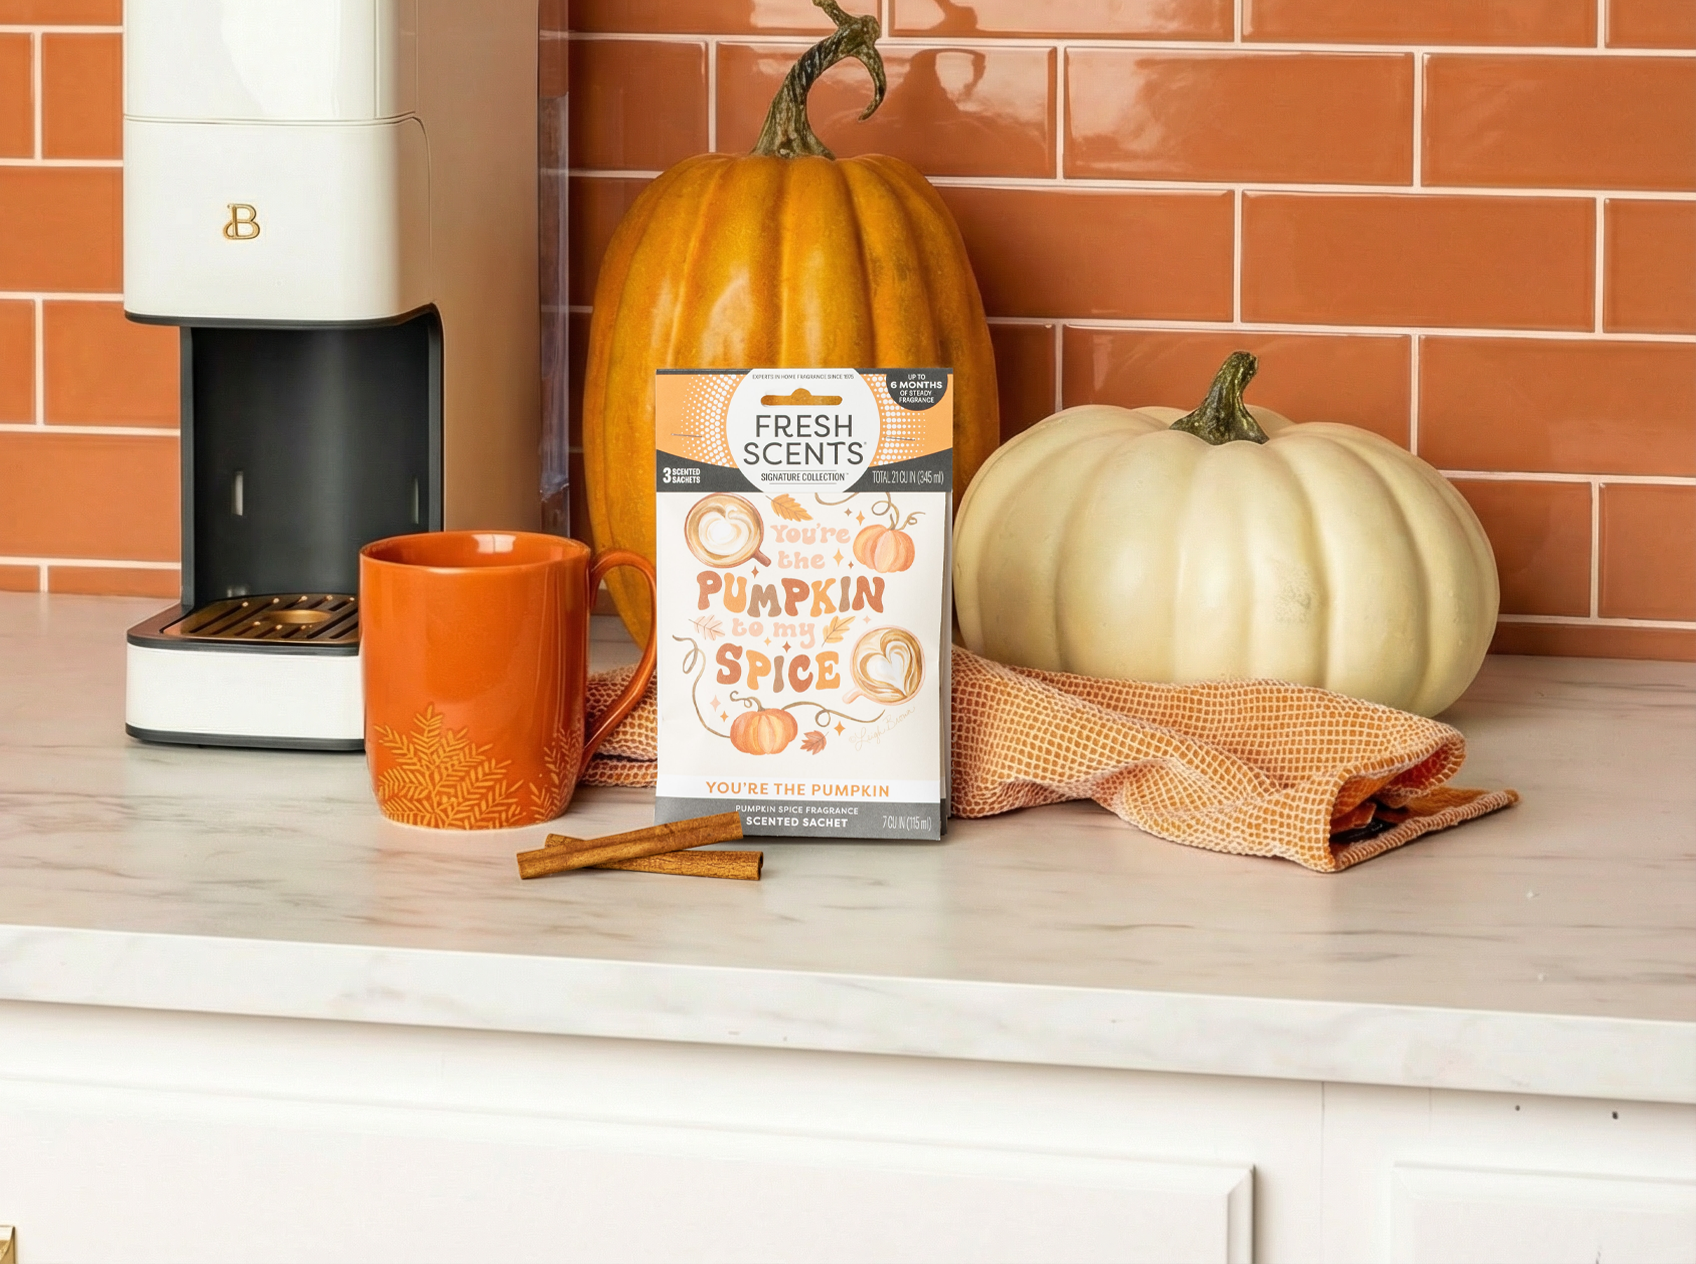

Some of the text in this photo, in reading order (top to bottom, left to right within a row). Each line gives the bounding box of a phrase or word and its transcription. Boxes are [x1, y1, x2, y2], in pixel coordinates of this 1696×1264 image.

[899, 381, 943, 389] MONTHS
[755, 414, 853, 438] FRESH
[662, 467, 672, 484] 3
[672, 468, 701, 476] SCENTED
[672, 476, 701, 484] SACHETS
[760, 473, 801, 482] SIGNATURE
[872, 470, 945, 485] TOTAL 21 CU IN (345 ml)
[770, 523, 851, 545] You're
[777, 550, 826, 569] the
[696, 570, 886, 618] PUMPKIN
[731, 617, 816, 650] to my
[715, 642, 841, 694] SPICE
[705, 781, 890, 798] YOU'RE THE PUMPKIN
[735, 805, 859, 815] PUMPKIN SPICE FRAGRANCE
[746, 816, 849, 828] SCENTED SACHET
[882, 815, 932, 832] 7 CU IN (115 ml)
